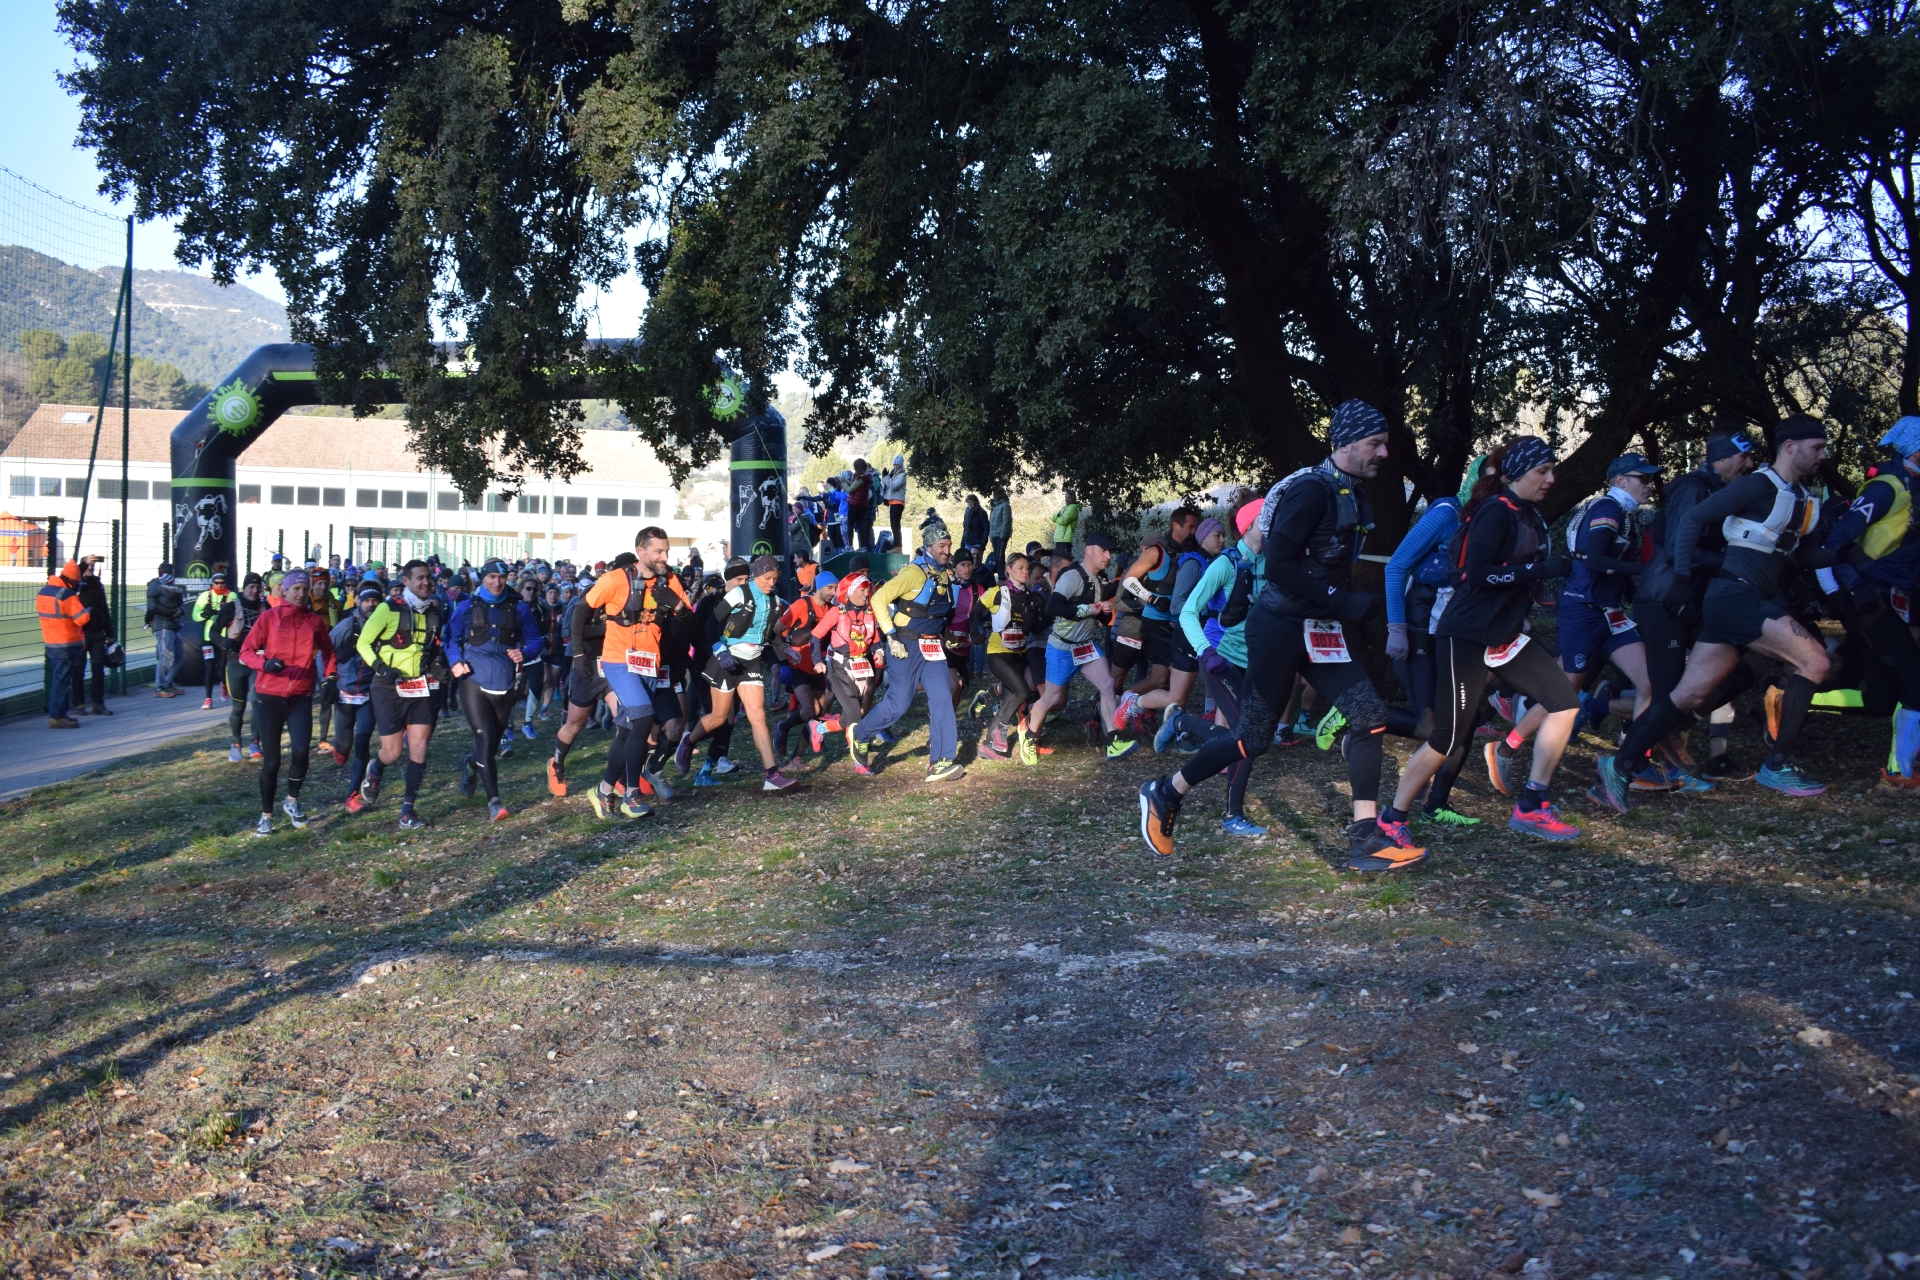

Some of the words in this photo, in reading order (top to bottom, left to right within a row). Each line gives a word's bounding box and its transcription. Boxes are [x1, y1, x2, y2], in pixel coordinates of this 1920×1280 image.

[1313, 633, 1340, 648] 3073
[630, 656, 651, 667] 3028
[400, 681, 421, 689] 3092
